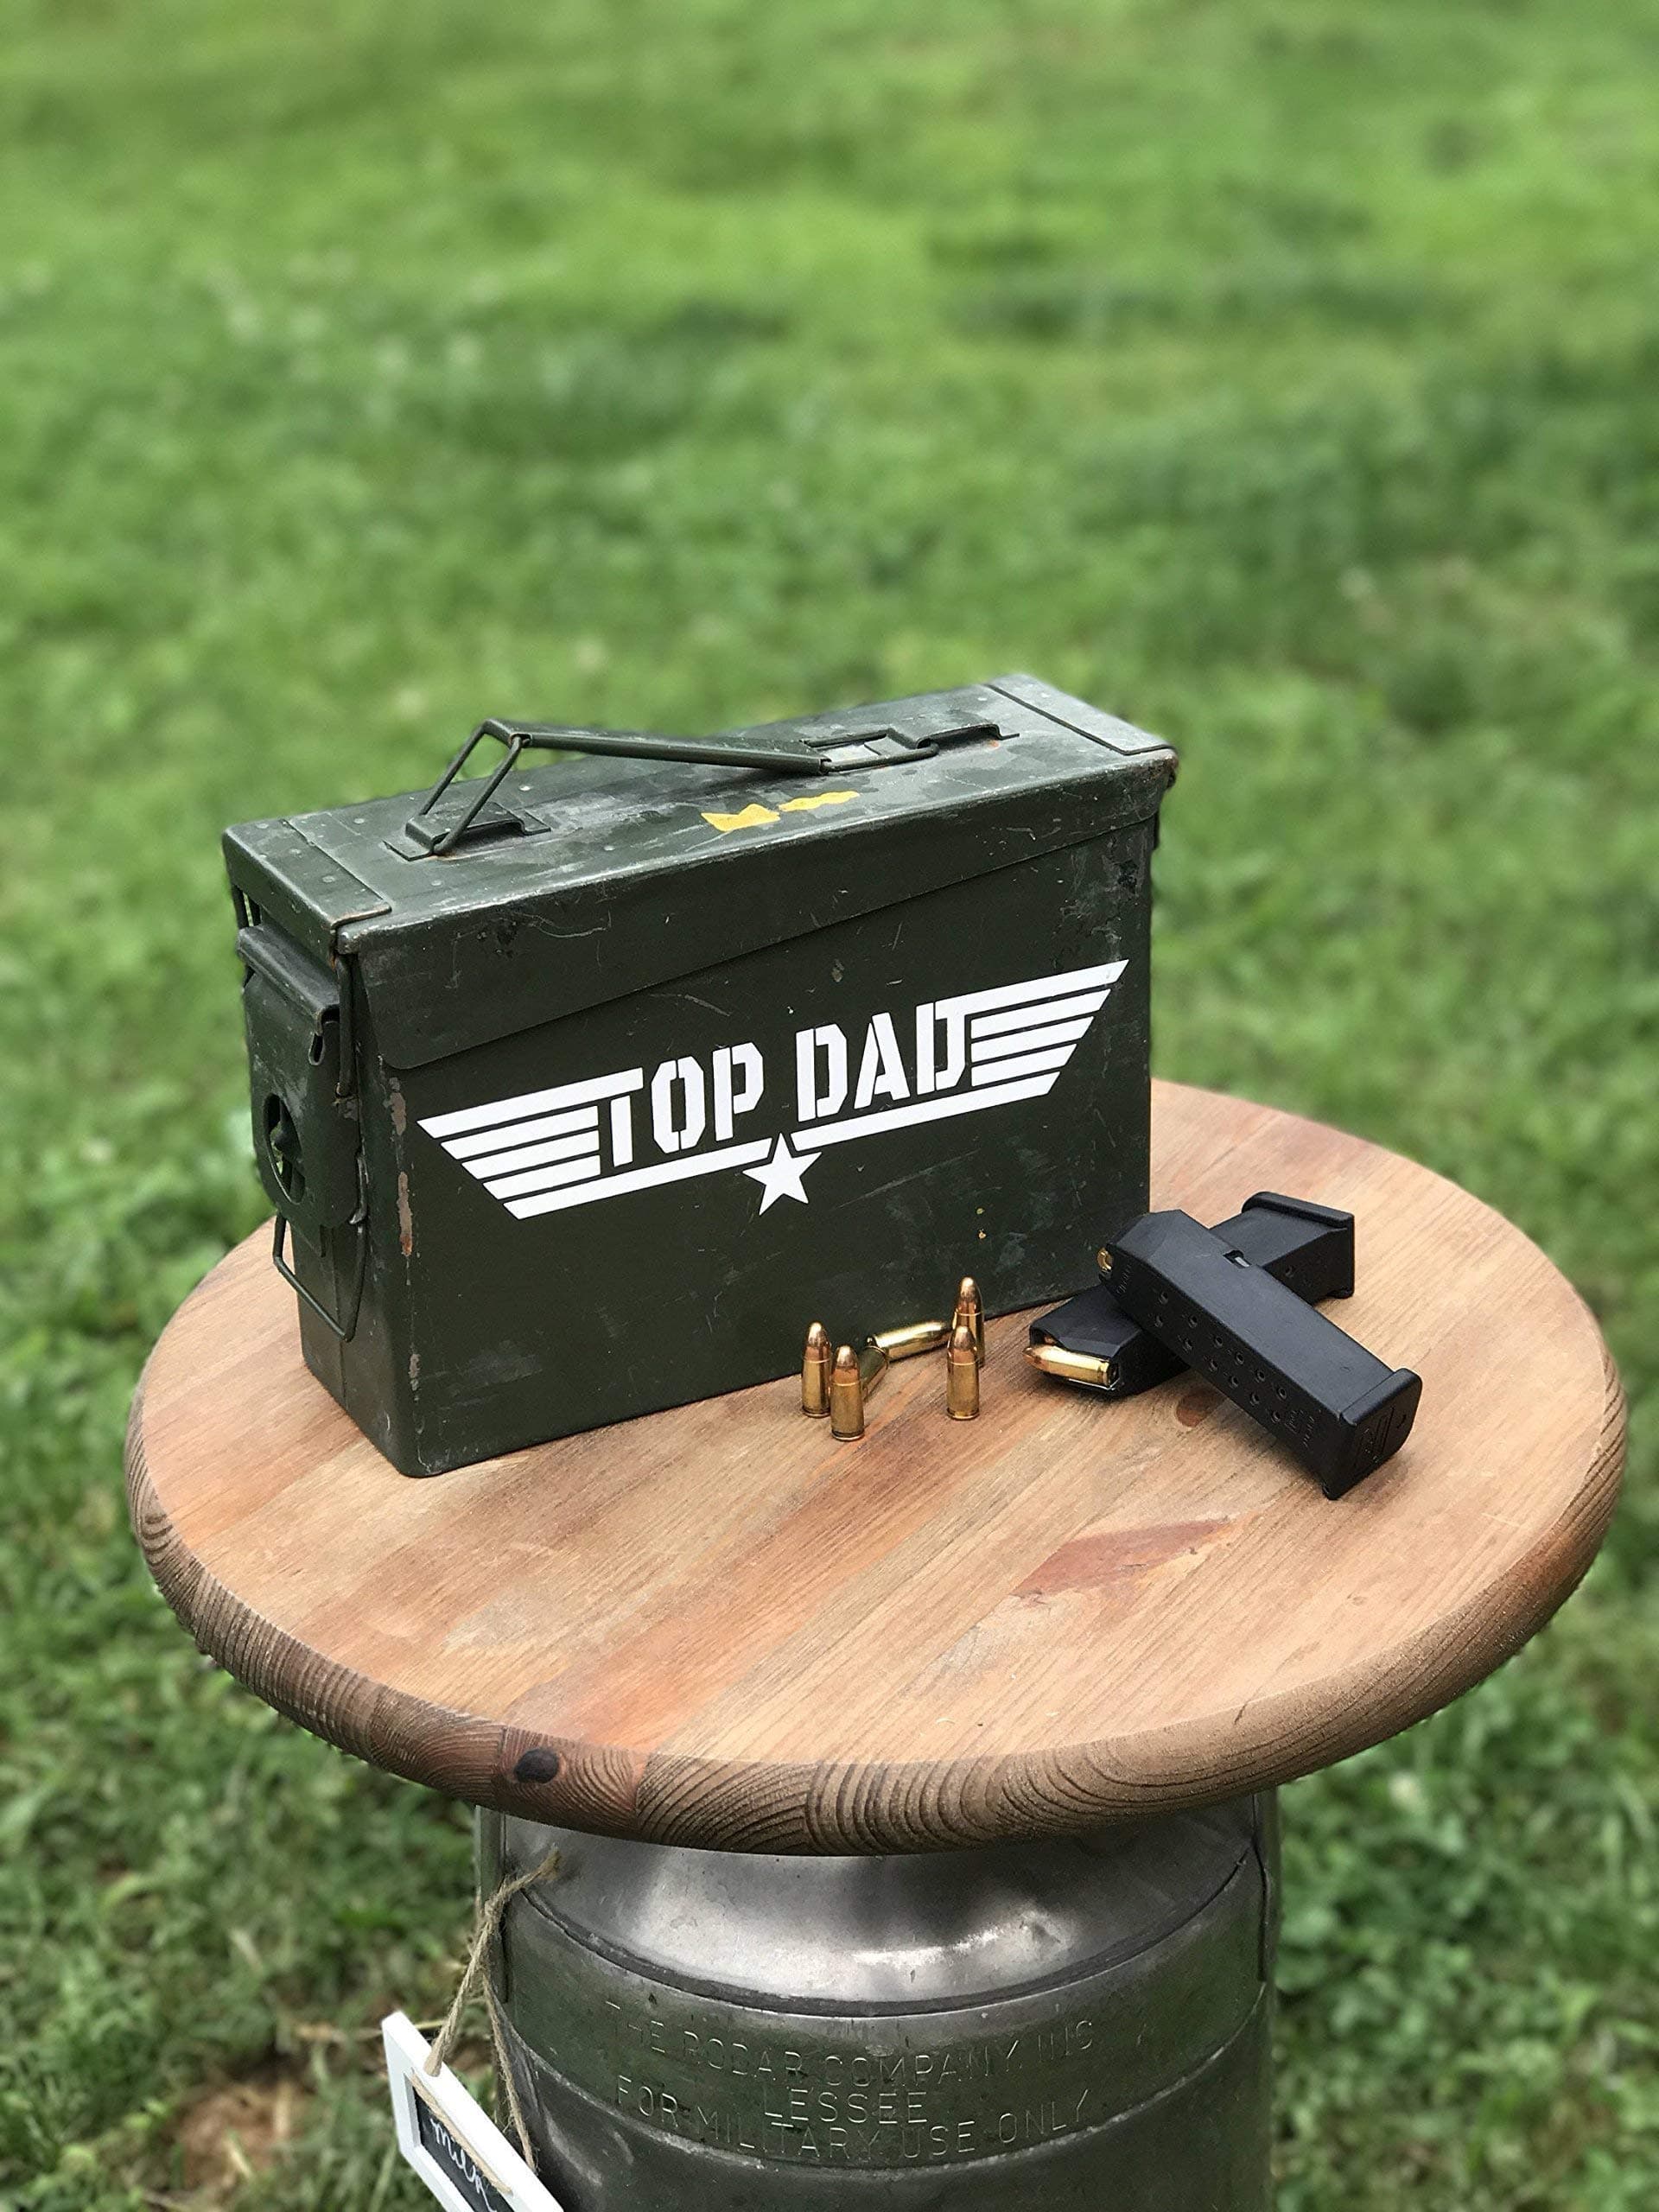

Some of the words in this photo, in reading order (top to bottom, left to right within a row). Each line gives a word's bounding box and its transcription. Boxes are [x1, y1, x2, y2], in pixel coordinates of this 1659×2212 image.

[597, 1042, 765, 1167] TOP
[796, 1002, 968, 1122] DAD
[618, 2075, 678, 2127] FOR
[696, 2106, 880, 2159] MILITARY
[902, 2120, 976, 2158] USE
[998, 2088, 1089, 2145] ONLY
[764, 2084, 928, 2124] LESSEE
